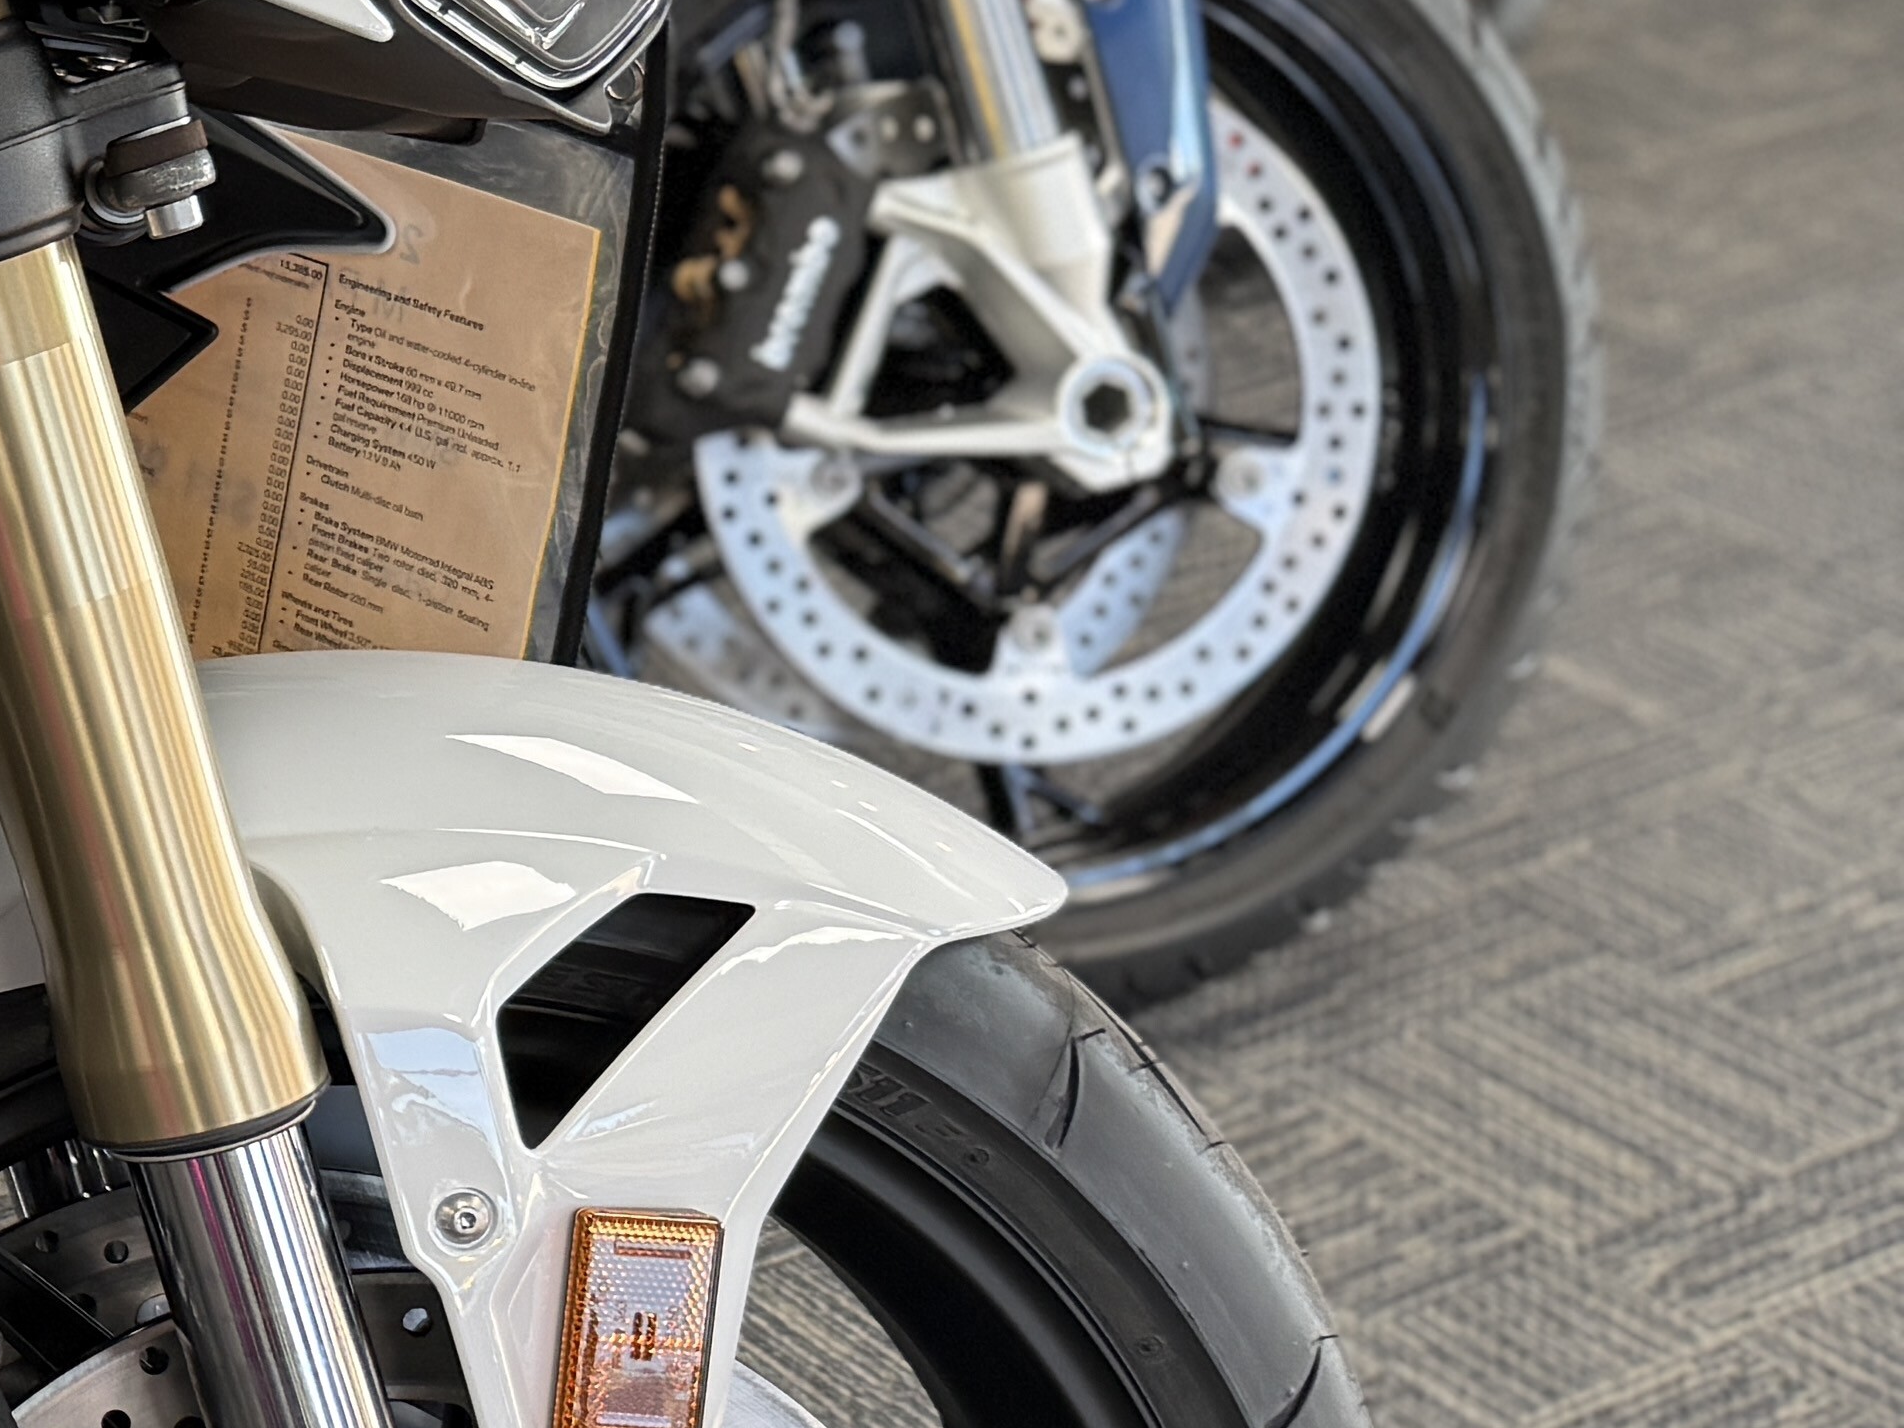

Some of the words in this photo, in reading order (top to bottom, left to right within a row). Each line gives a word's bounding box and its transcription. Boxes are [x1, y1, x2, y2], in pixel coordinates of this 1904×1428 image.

[334, 299, 366, 317] Engine
[338, 273, 392, 301] Engineering
[393, 295, 411, 305] and
[412, 299, 442, 318] Safety
[443, 309, 484, 331] Features
[296, 315, 314, 329] 0.00
[291, 341, 310, 354] 0.00
[347, 333, 376, 349] engine
[351, 319, 373, 334] Type
[388, 334, 405, 345] and
[406, 340, 462, 365] water-cooled
[463, 359, 507, 381] 4-cylinder
[289, 353, 307, 367] 0.00
[345, 345, 367, 360] Bore
[374, 355, 405, 374] Stroke
[286, 365, 305, 379] 0.00
[343, 358, 403, 388] Displacement
[284, 378, 303, 391] 0.00
[282, 390, 300, 404] 0.00
[340, 372, 395, 398] Horsepower
[413, 398, 425, 410] hp
[467, 419, 485, 431] rpm
[280, 403, 298, 416] 0.00
[335, 398, 355, 411] Fuel
[357, 406, 397, 429] Capacity
[337, 385, 357, 399] Fuel
[358, 392, 416, 421] Requirement
[417, 414, 456, 434] Premium
[457, 428, 500, 451] Unleaded
[278, 415, 296, 429] 0.00
[275, 428, 293, 441] 0.00
[330, 424, 370, 448] Charging
[372, 439, 405, 459] System
[272, 440, 291, 454] 0.00
[328, 437, 361, 458] Battery
[270, 452, 289, 466] 0.00
[306, 455, 349, 478] Drivetrain
[268, 464, 287, 478] 0.00
[321, 474, 349, 492] Clutch
[351, 485, 391, 509] Multi-disc
[299, 492, 329, 511] Brakes
[312, 524, 336, 540] Front
[338, 534, 369, 554] Brakes
[373, 548, 390, 563] Two
[314, 511, 339, 528] Brake
[340, 522, 374, 542] System
[376, 536, 399, 551] BMW
[401, 546, 440, 568] Motorrad
[307, 548, 328, 563] Rear
[331, 558, 357, 575] Brake
[303, 573, 322, 588] Rear
